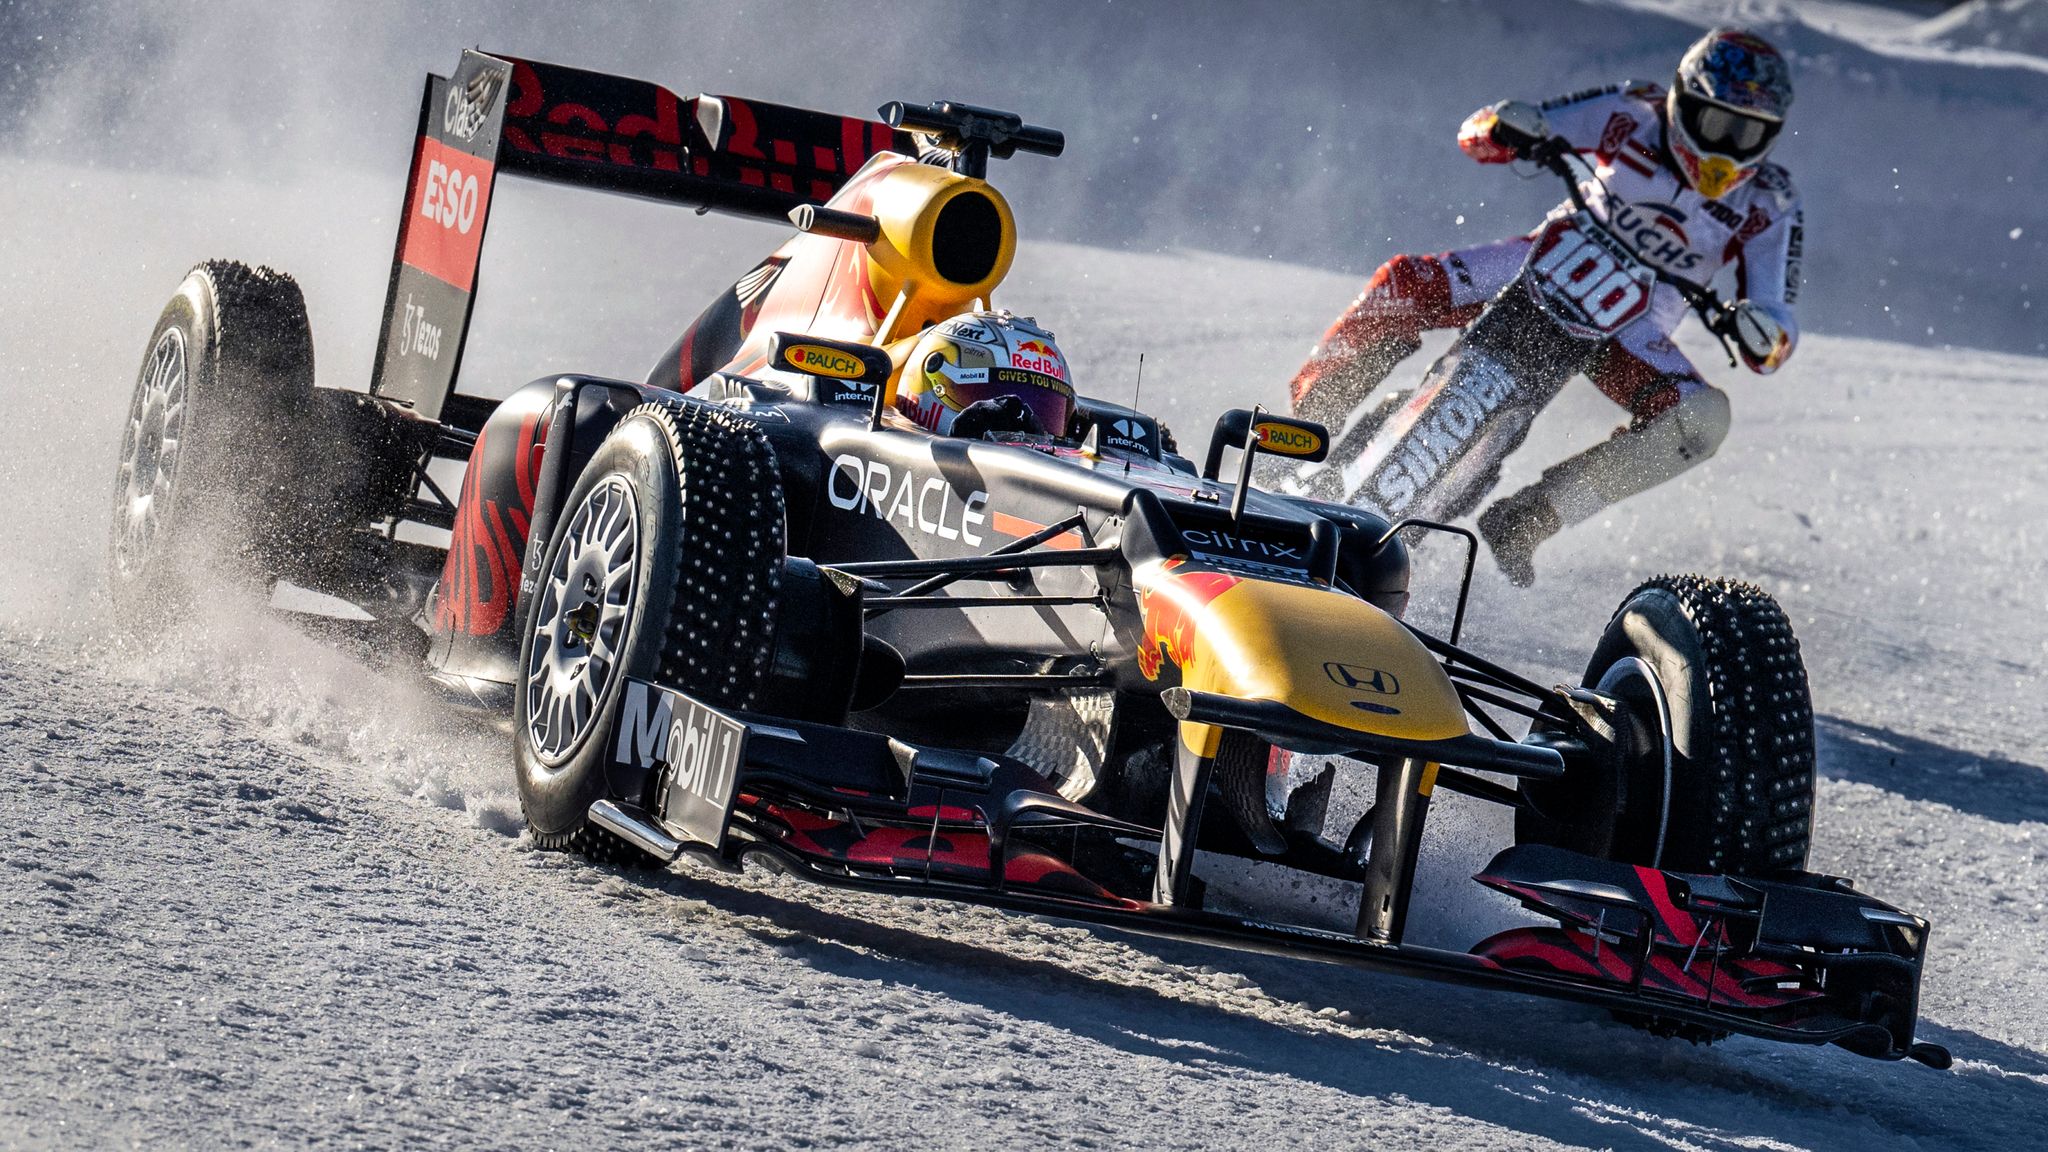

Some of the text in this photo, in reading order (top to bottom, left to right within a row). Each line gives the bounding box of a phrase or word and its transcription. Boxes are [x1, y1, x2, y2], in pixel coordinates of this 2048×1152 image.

[421, 159, 479, 235] ESSO
[1605, 195, 1703, 269] FUCHS
[1534, 229, 1642, 327] 100
[412, 305, 442, 361] Tezos
[805, 351, 856, 374] RAUCH
[998, 370, 1028, 383] GIVES
[1030, 373, 1049, 388] YOU
[1012, 353, 1064, 379] Red Bull
[1269, 430, 1312, 449] RAUCH
[828, 453, 990, 548] ORACLE
[1182, 529, 1301, 560] citrix
[520, 573, 537, 594] Tez
[616, 680, 732, 800] Mobil 1
